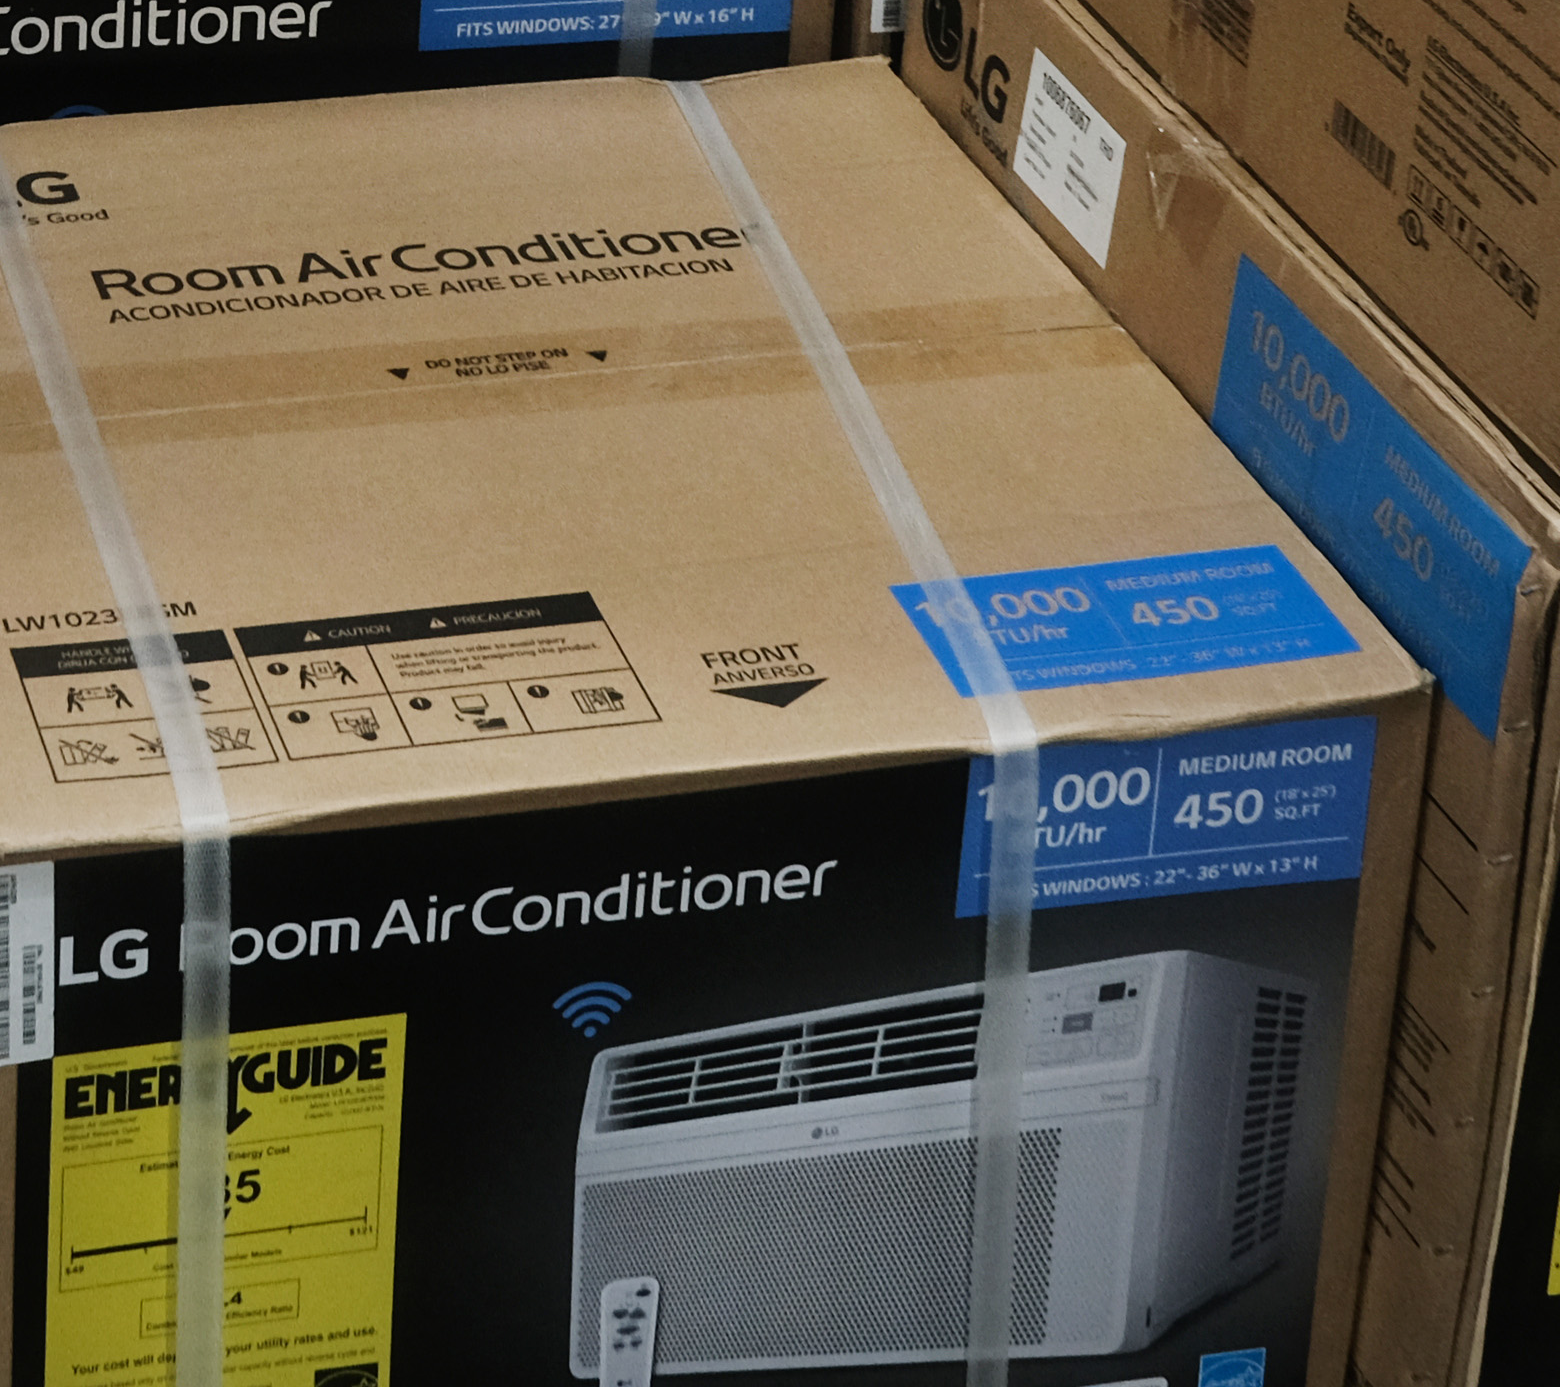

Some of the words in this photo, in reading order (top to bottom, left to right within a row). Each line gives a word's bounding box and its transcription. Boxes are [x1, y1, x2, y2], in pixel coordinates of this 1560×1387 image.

[90, 261, 283, 302] Room
[108, 284, 387, 325] ACONDICIONADOR
[391, 282, 431, 300] DE
[438, 275, 506, 297] AIRE
[511, 272, 553, 291] DE
[555, 256, 735, 286] HABITACION
[424, 358, 450, 371] DO
[454, 355, 489, 369] NOT
[492, 351, 535, 366] STEP
[540, 347, 569, 360] ON
[1131, 595, 1221, 629] 450
[327, 623, 391, 640] CAUTION
[699, 642, 803, 670] FRONT
[712, 662, 817, 685] ANVERSO
[1179, 749, 1277, 777] MEDIUM
[1281, 743, 1353, 766] ROOM
[1174, 788, 1264, 829] 450
[58, 928, 150, 987] LG
